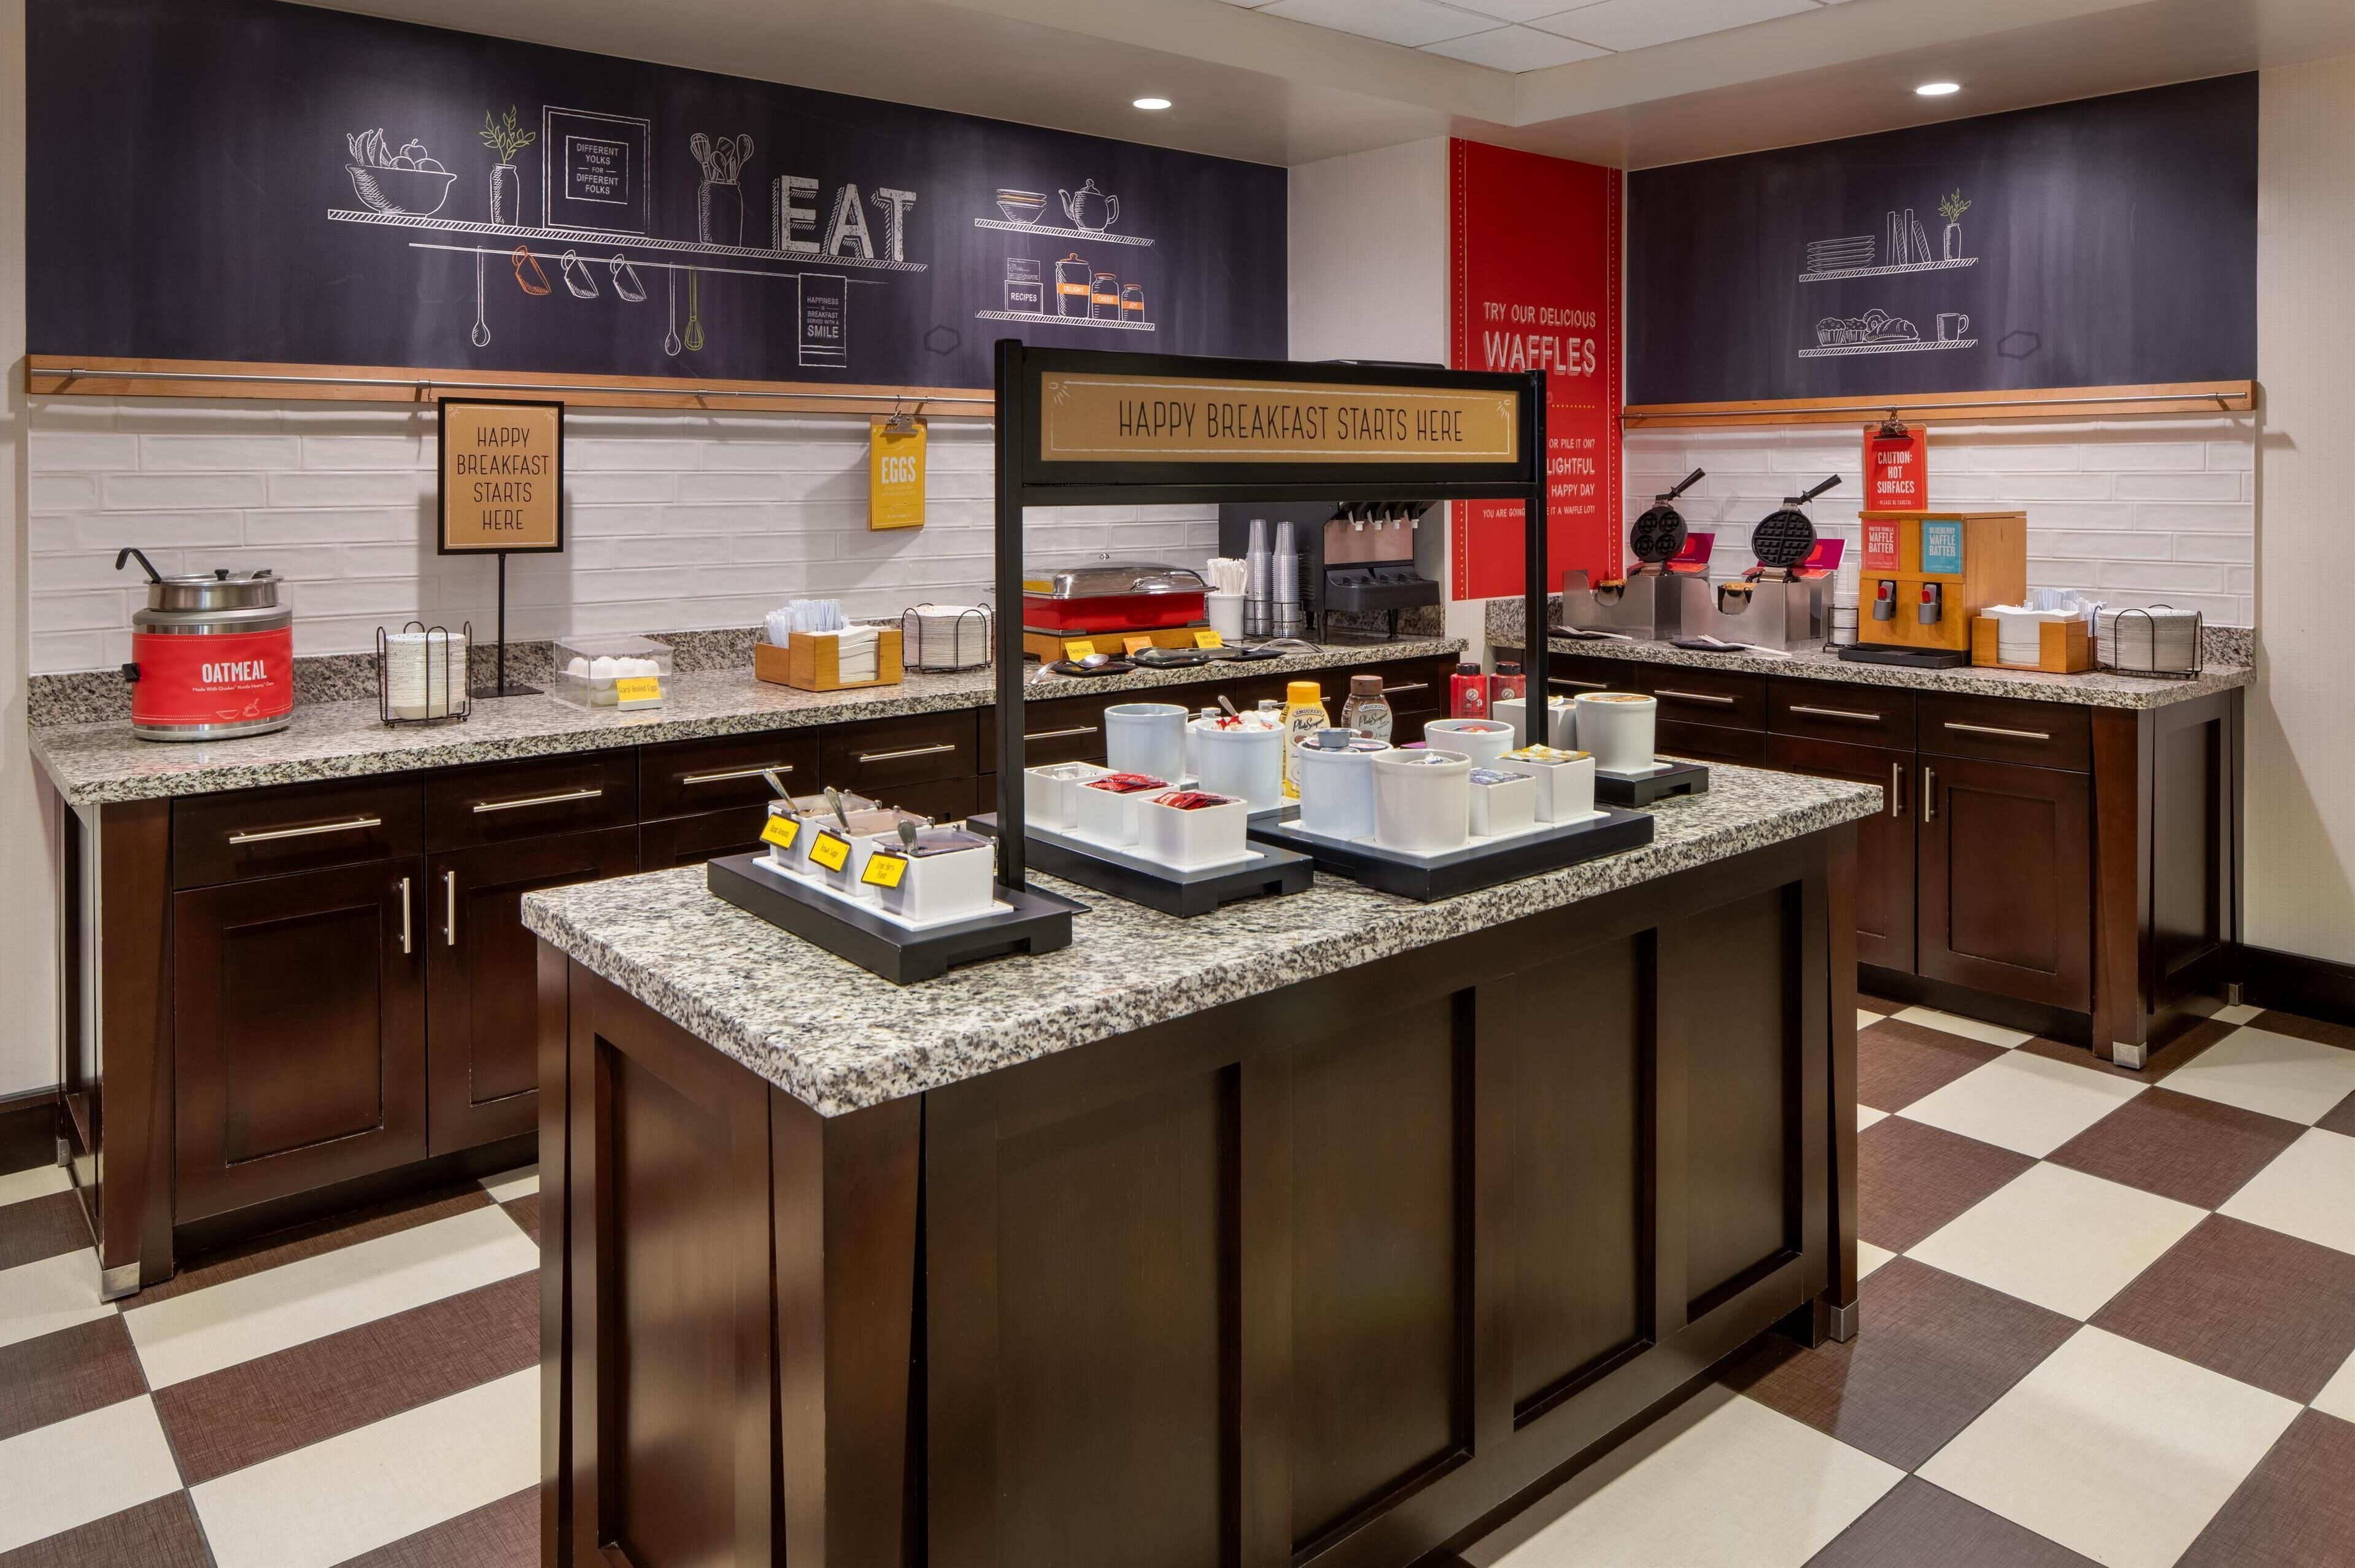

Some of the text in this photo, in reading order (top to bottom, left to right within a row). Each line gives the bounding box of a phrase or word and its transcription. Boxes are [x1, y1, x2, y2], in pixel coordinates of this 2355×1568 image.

[577, 143, 619, 156] DIFFERENT
[586, 154, 611, 165] YOLKS
[577, 173, 619, 186] DIFFERENT
[585, 184, 610, 195] FOLKS
[773, 175, 916, 262] EAT
[806, 296, 839, 305] HAPPINESS
[1011, 292, 1037, 302] RECIPES
[807, 311, 838, 319] BREAKFAST
[1483, 302, 1596, 329] TRY OUR DELICIOUS
[807, 325, 839, 338] SMILE
[1483, 330, 1596, 377] WAFFLES
[1119, 400, 1463, 441] HAPPY BREAKFAST STARTS HERE
[477, 427, 530, 448] HAPPY
[1549, 438, 1595, 449] OR PILE IT ON?
[1878, 451, 1912, 464] CAUTION:
[457, 454, 549, 475] BREAKFAST
[881, 456, 916, 484] EGGS
[1547, 457, 1595, 476] LIGHTFUL
[1888, 466, 1903, 479] HOT
[474, 482, 532, 503] STARTS
[1551, 483, 1595, 498] HAPPY DAY
[1877, 481, 1915, 493] SURFACES
[1483, 508, 1525, 518] YOU ARE GOING
[1551, 507, 1556, 515] IT
[1557, 506, 1562, 515] A
[1564, 505, 1583, 514] WAFFLE
[1584, 505, 1595, 514] LOT!
[483, 509, 524, 530] HERE
[1869, 532, 1894, 543] WAFFLE
[1929, 534, 1956, 545] WAFFLE
[1869, 543, 1894, 554] BATTER
[1929, 545, 1955, 556] BATTER
[202, 660, 267, 683] OATMEAL
[619, 685, 646, 693] Hard-Boiled
